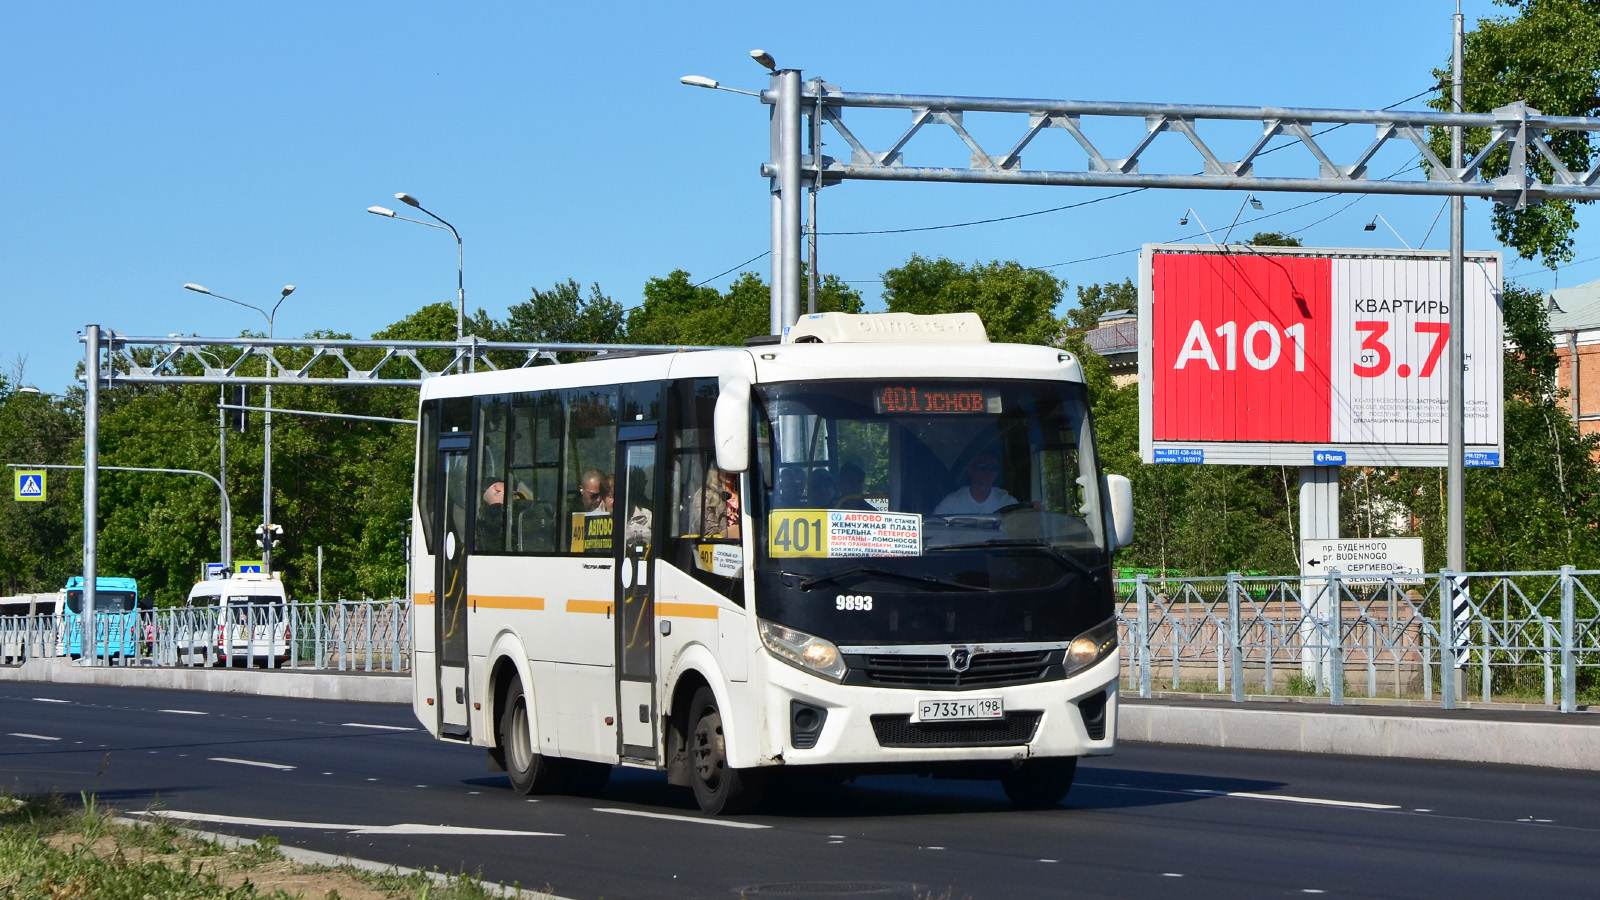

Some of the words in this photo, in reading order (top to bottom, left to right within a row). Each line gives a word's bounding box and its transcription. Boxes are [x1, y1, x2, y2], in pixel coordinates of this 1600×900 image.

[1353, 320, 1450, 378] 3.7
[881, 386, 920, 411] 401
[1325, 453, 1343, 461] Russ
[844, 514, 882, 522] АВТОВО
[588, 517, 614, 536] АВТОВО
[831, 521, 887, 530] ЖЕМЧУЖНАЯ
[890, 523, 917, 532] ПЛАЗА
[774, 517, 822, 552] 401
[831, 528, 872, 536] СТРЕЛЬНА
[877, 530, 918, 538] ПЕТЕРГОФ
[872, 536, 917, 544] ЛОМОНОСОВ
[1322, 545, 1335, 553] пр.
[1337, 543, 1387, 552] БУДЕННОГО
[700, 550, 713, 564] 401
[1323, 554, 1334, 562] pr.
[1336, 552, 1387, 560] BUDENNOGO
[1347, 563, 1393, 572] СЕРГИЕВО
[835, 594, 873, 611] 9893
[923, 702, 976, 717] Р733ТК
[978, 700, 998, 712] 198
